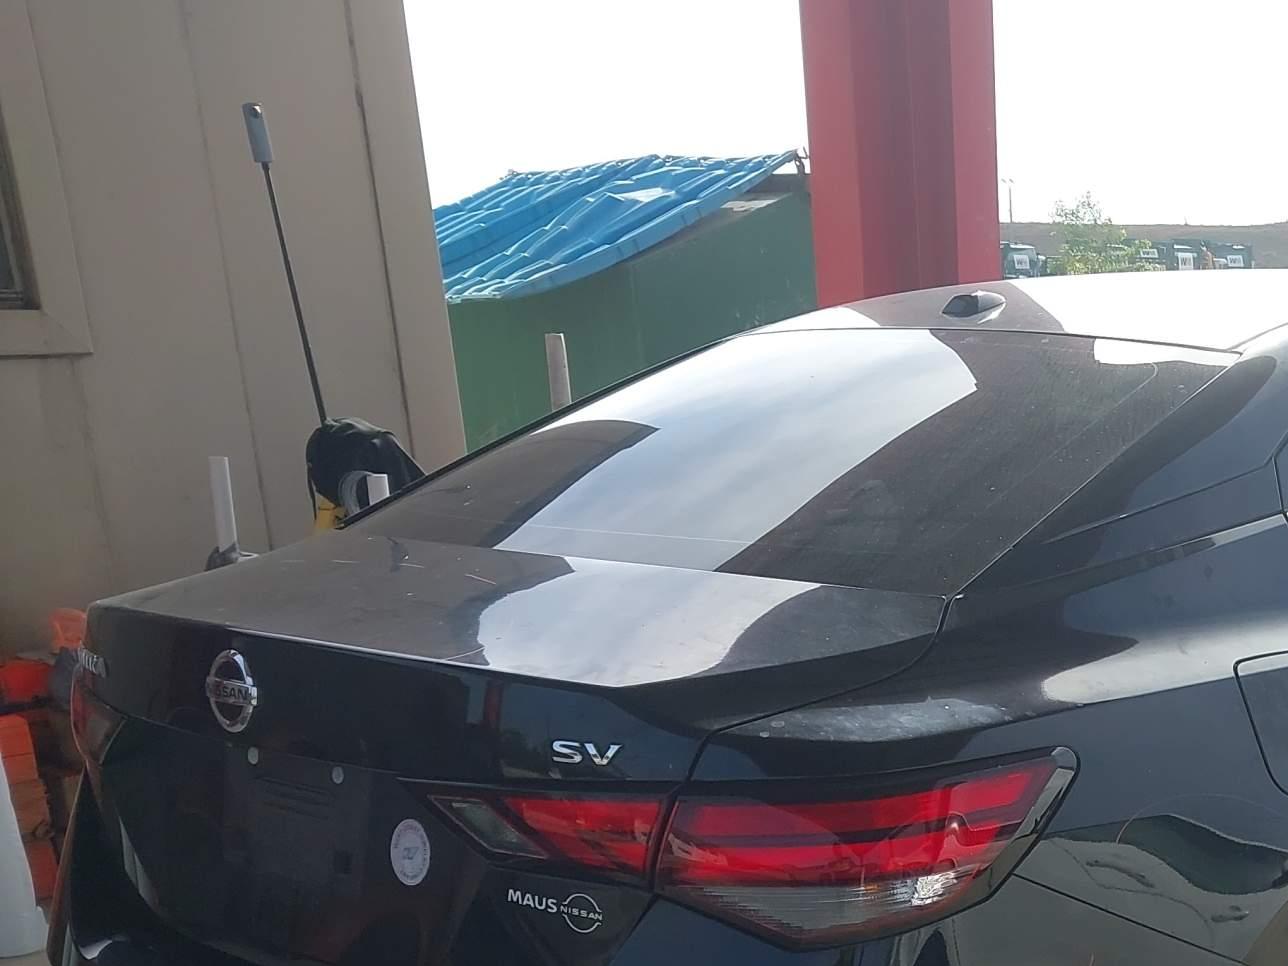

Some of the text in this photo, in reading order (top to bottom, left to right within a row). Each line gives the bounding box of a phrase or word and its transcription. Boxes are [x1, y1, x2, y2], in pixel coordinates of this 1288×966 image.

[552, 740, 623, 766] SV
[508, 889, 603, 920] MAUS NISSAN
